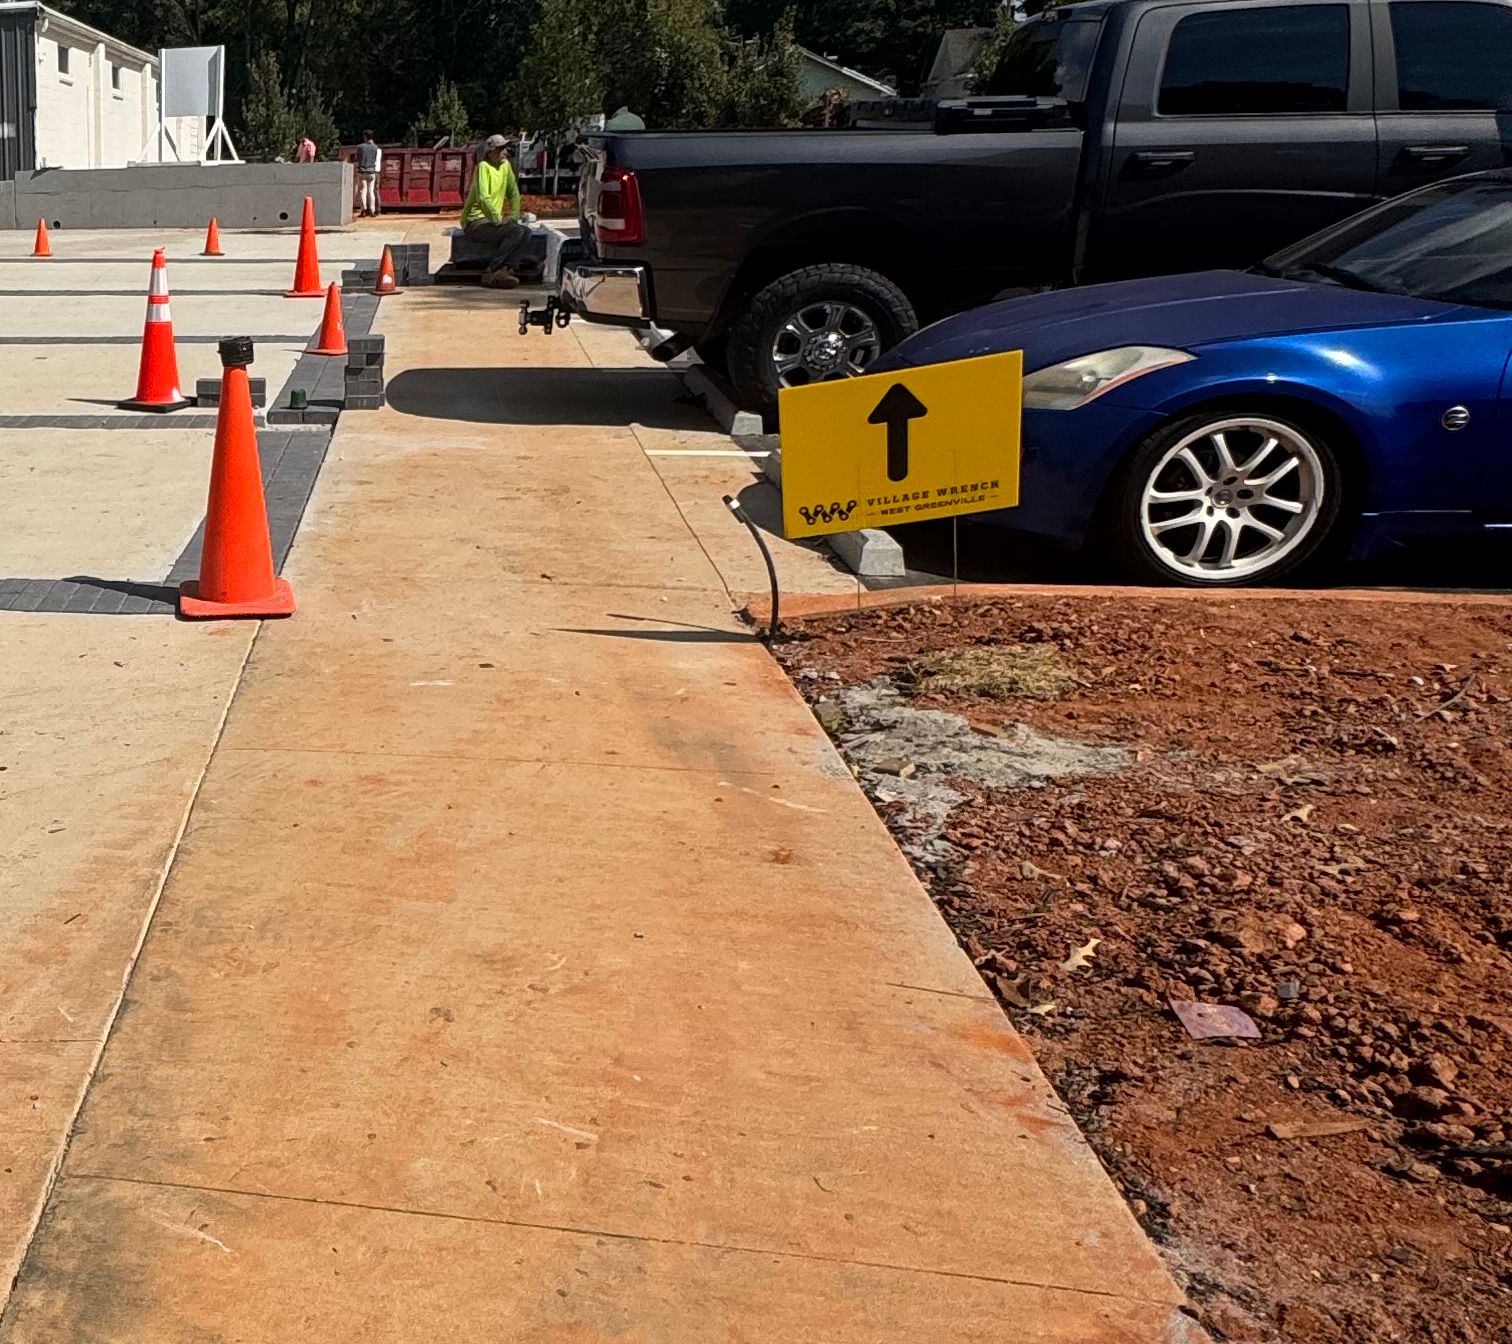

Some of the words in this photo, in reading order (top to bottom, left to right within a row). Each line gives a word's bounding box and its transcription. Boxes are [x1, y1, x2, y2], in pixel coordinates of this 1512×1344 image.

[867, 490, 930, 507] VILLAGE
[936, 480, 1000, 497] WRENCH
[881, 505, 913, 515] WEST
[914, 494, 986, 511] GREENVILLE
